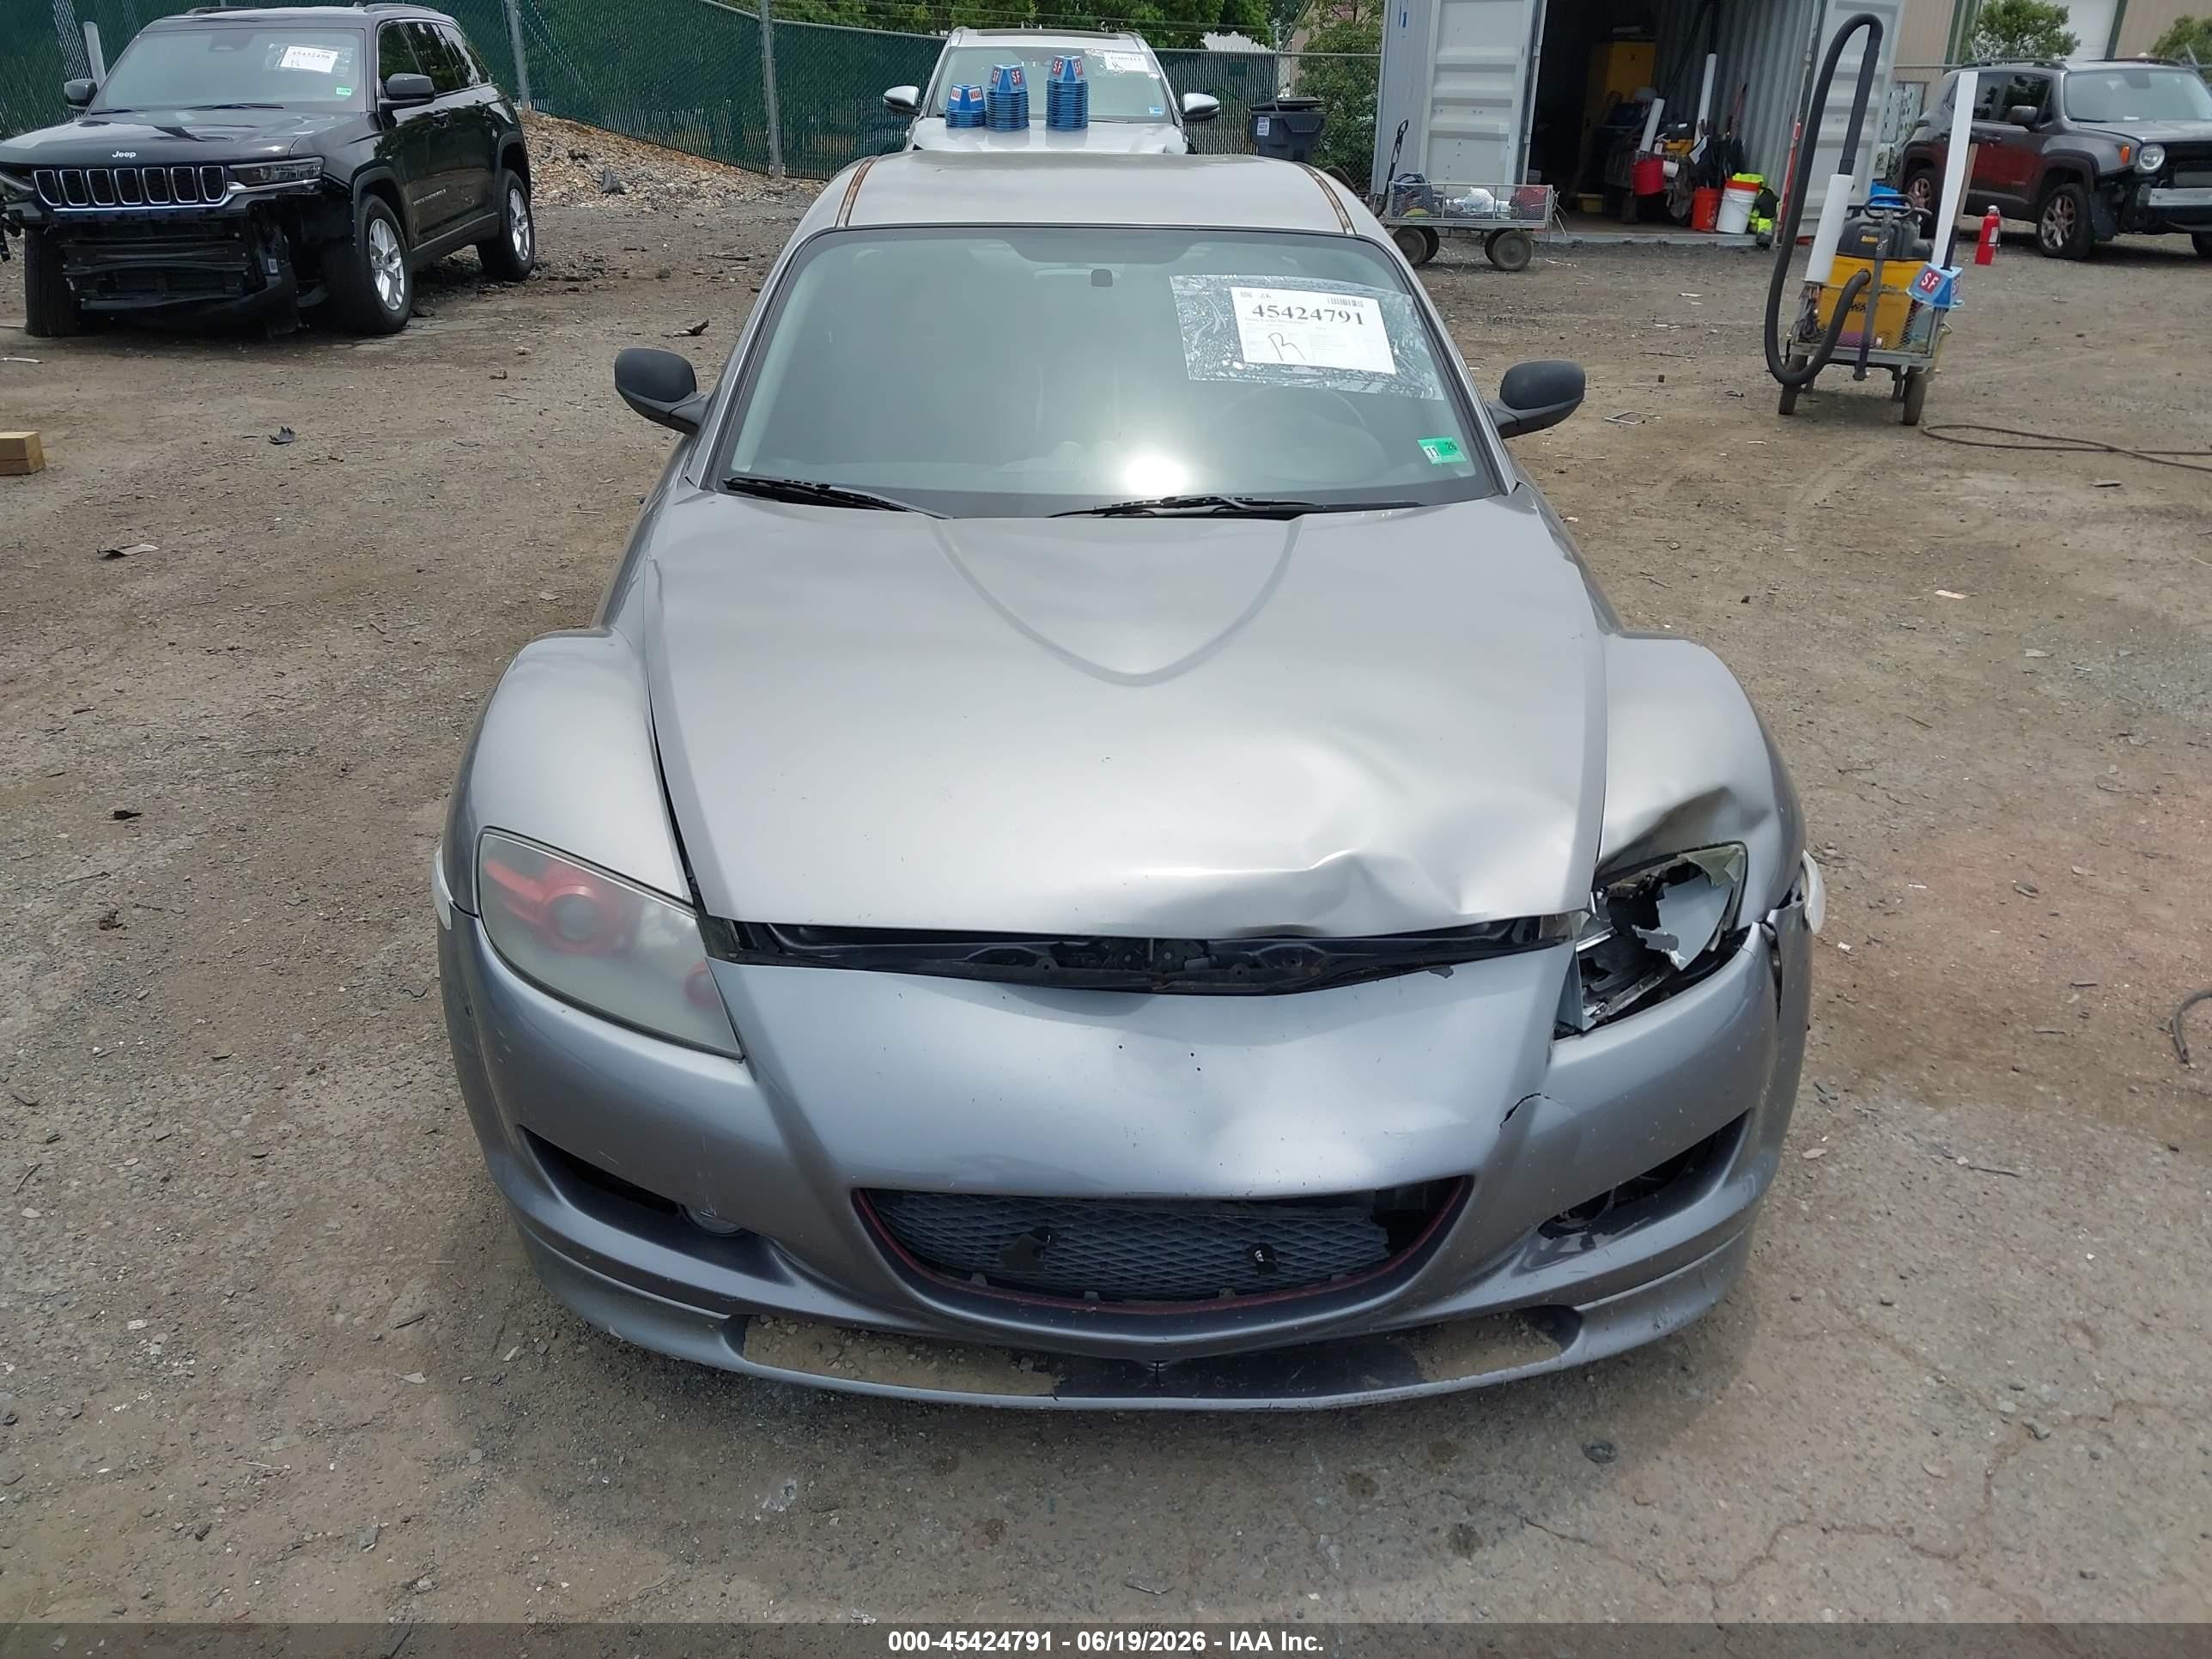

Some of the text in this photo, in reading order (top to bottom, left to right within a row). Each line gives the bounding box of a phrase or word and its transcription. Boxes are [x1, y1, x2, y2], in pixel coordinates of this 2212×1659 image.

[1053, 61, 1063, 73] SF
[1011, 70, 1021, 83] SF
[112, 150, 137, 159] Jeep
[1921, 272, 1940, 289] SF
[1252, 304, 1364, 325] 45424791
[1426, 447, 1440, 458] 11
